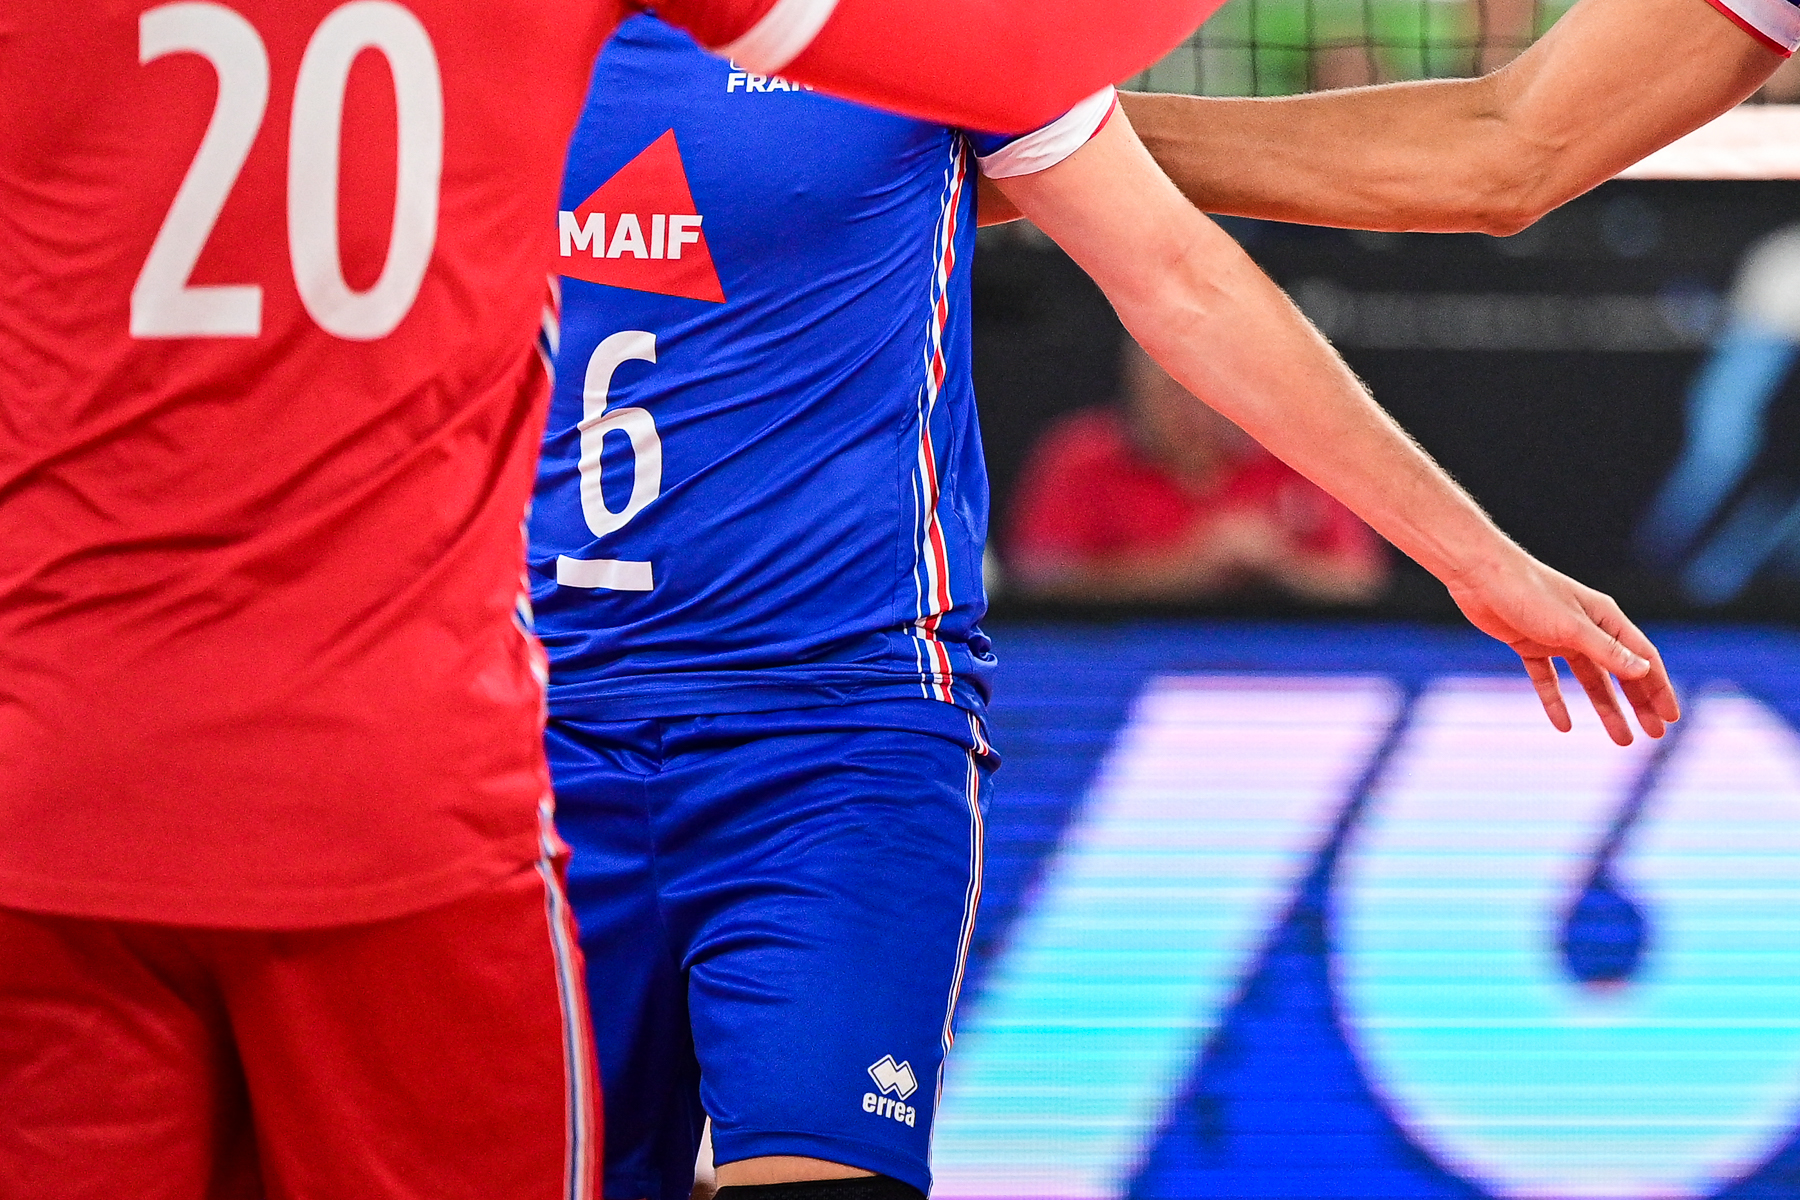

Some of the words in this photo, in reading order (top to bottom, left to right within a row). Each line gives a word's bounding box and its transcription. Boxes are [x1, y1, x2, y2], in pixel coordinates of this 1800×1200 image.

[130, 0, 443, 339] 20
[558, 210, 704, 260] MAIF
[576, 330, 662, 539] 6
